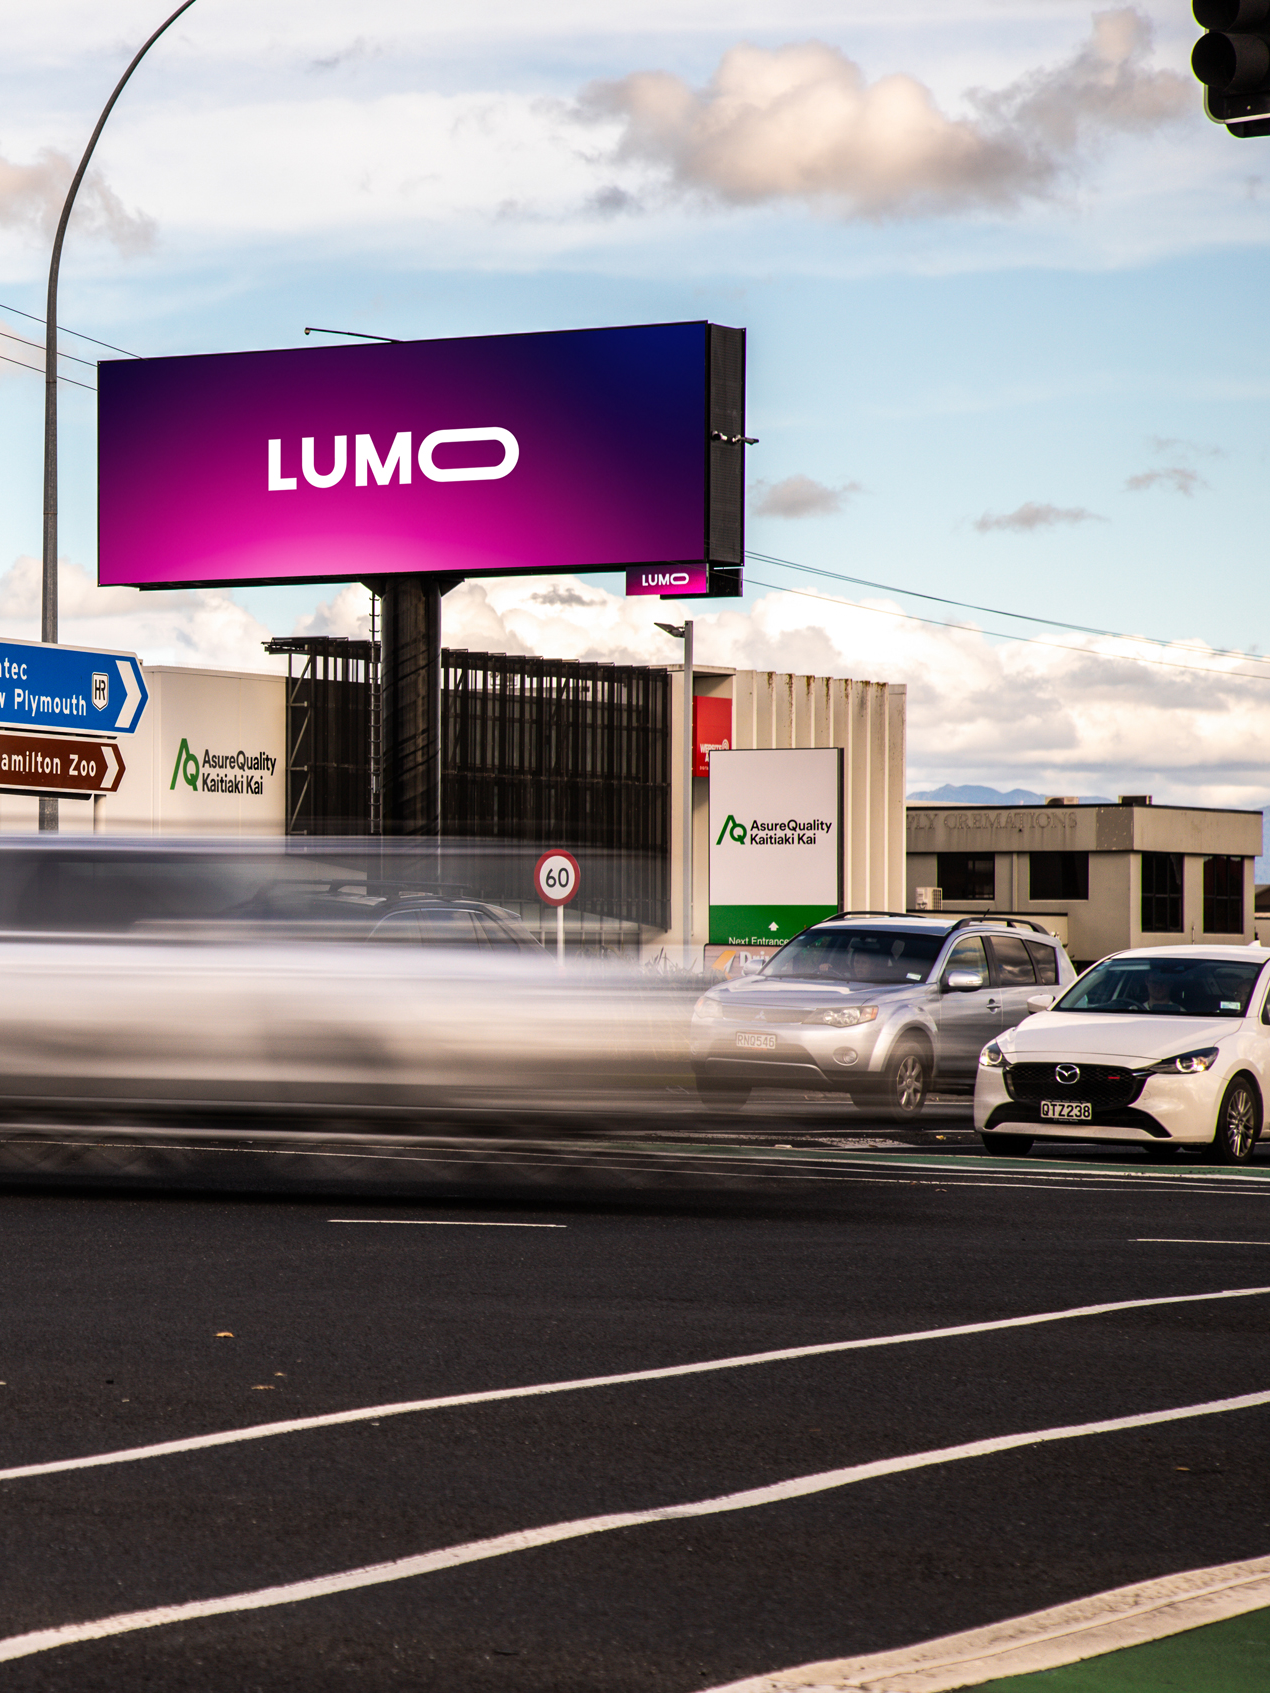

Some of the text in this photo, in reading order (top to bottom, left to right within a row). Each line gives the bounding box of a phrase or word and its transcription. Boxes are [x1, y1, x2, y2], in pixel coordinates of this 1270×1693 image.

[268, 426, 520, 491] LUMO
[642, 572, 689, 586] LUMO
[14, 688, 87, 717] Plymouth
[69, 754, 96, 777] Zoo
[202, 748, 277, 776] AsureQuality
[202, 772, 263, 795] Kaitiaki Kai
[750, 819, 832, 834] AsureQuality
[906, 812, 1078, 830] PLY CREMATIONS
[750, 832, 817, 845] Kaitiaki Kai
[545, 867, 570, 888] 60
[728, 937, 790, 946] Next Entrance
[737, 1034, 775, 1048] RNQ546
[1042, 1103, 1091, 1118] QTZ238
